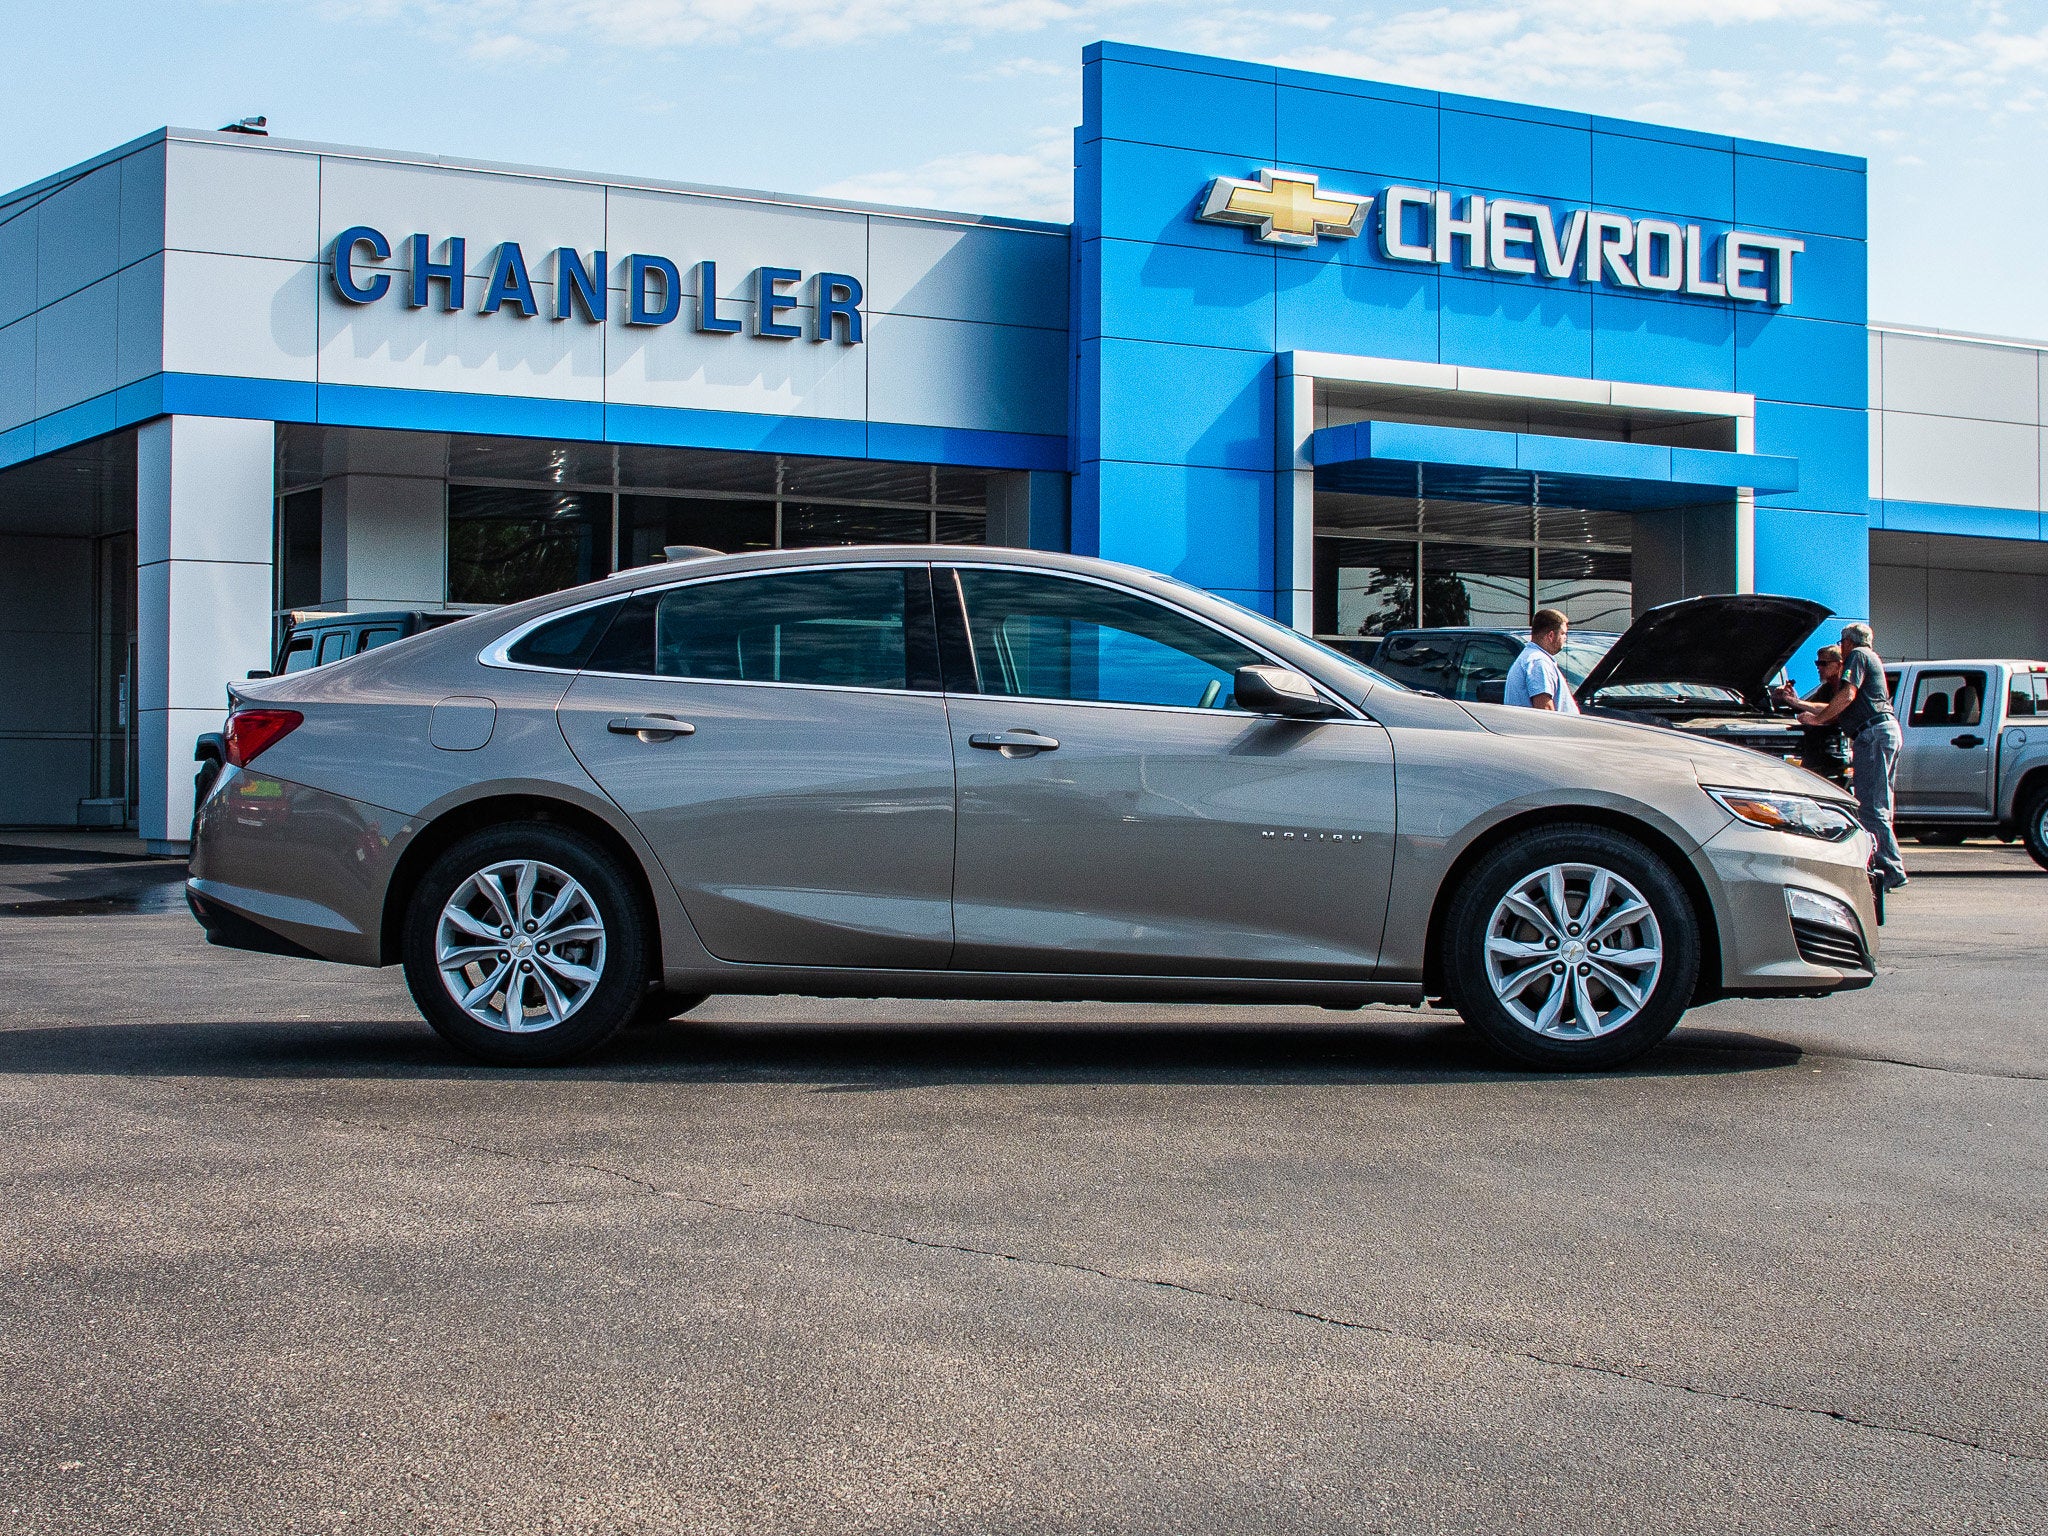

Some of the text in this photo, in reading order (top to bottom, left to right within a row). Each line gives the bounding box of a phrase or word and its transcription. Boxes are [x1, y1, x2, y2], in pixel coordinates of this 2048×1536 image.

[329, 225, 864, 345] CHANDLER
[1378, 185, 1805, 305] CHEVROLET
[1261, 830, 1363, 843] MALIBU
